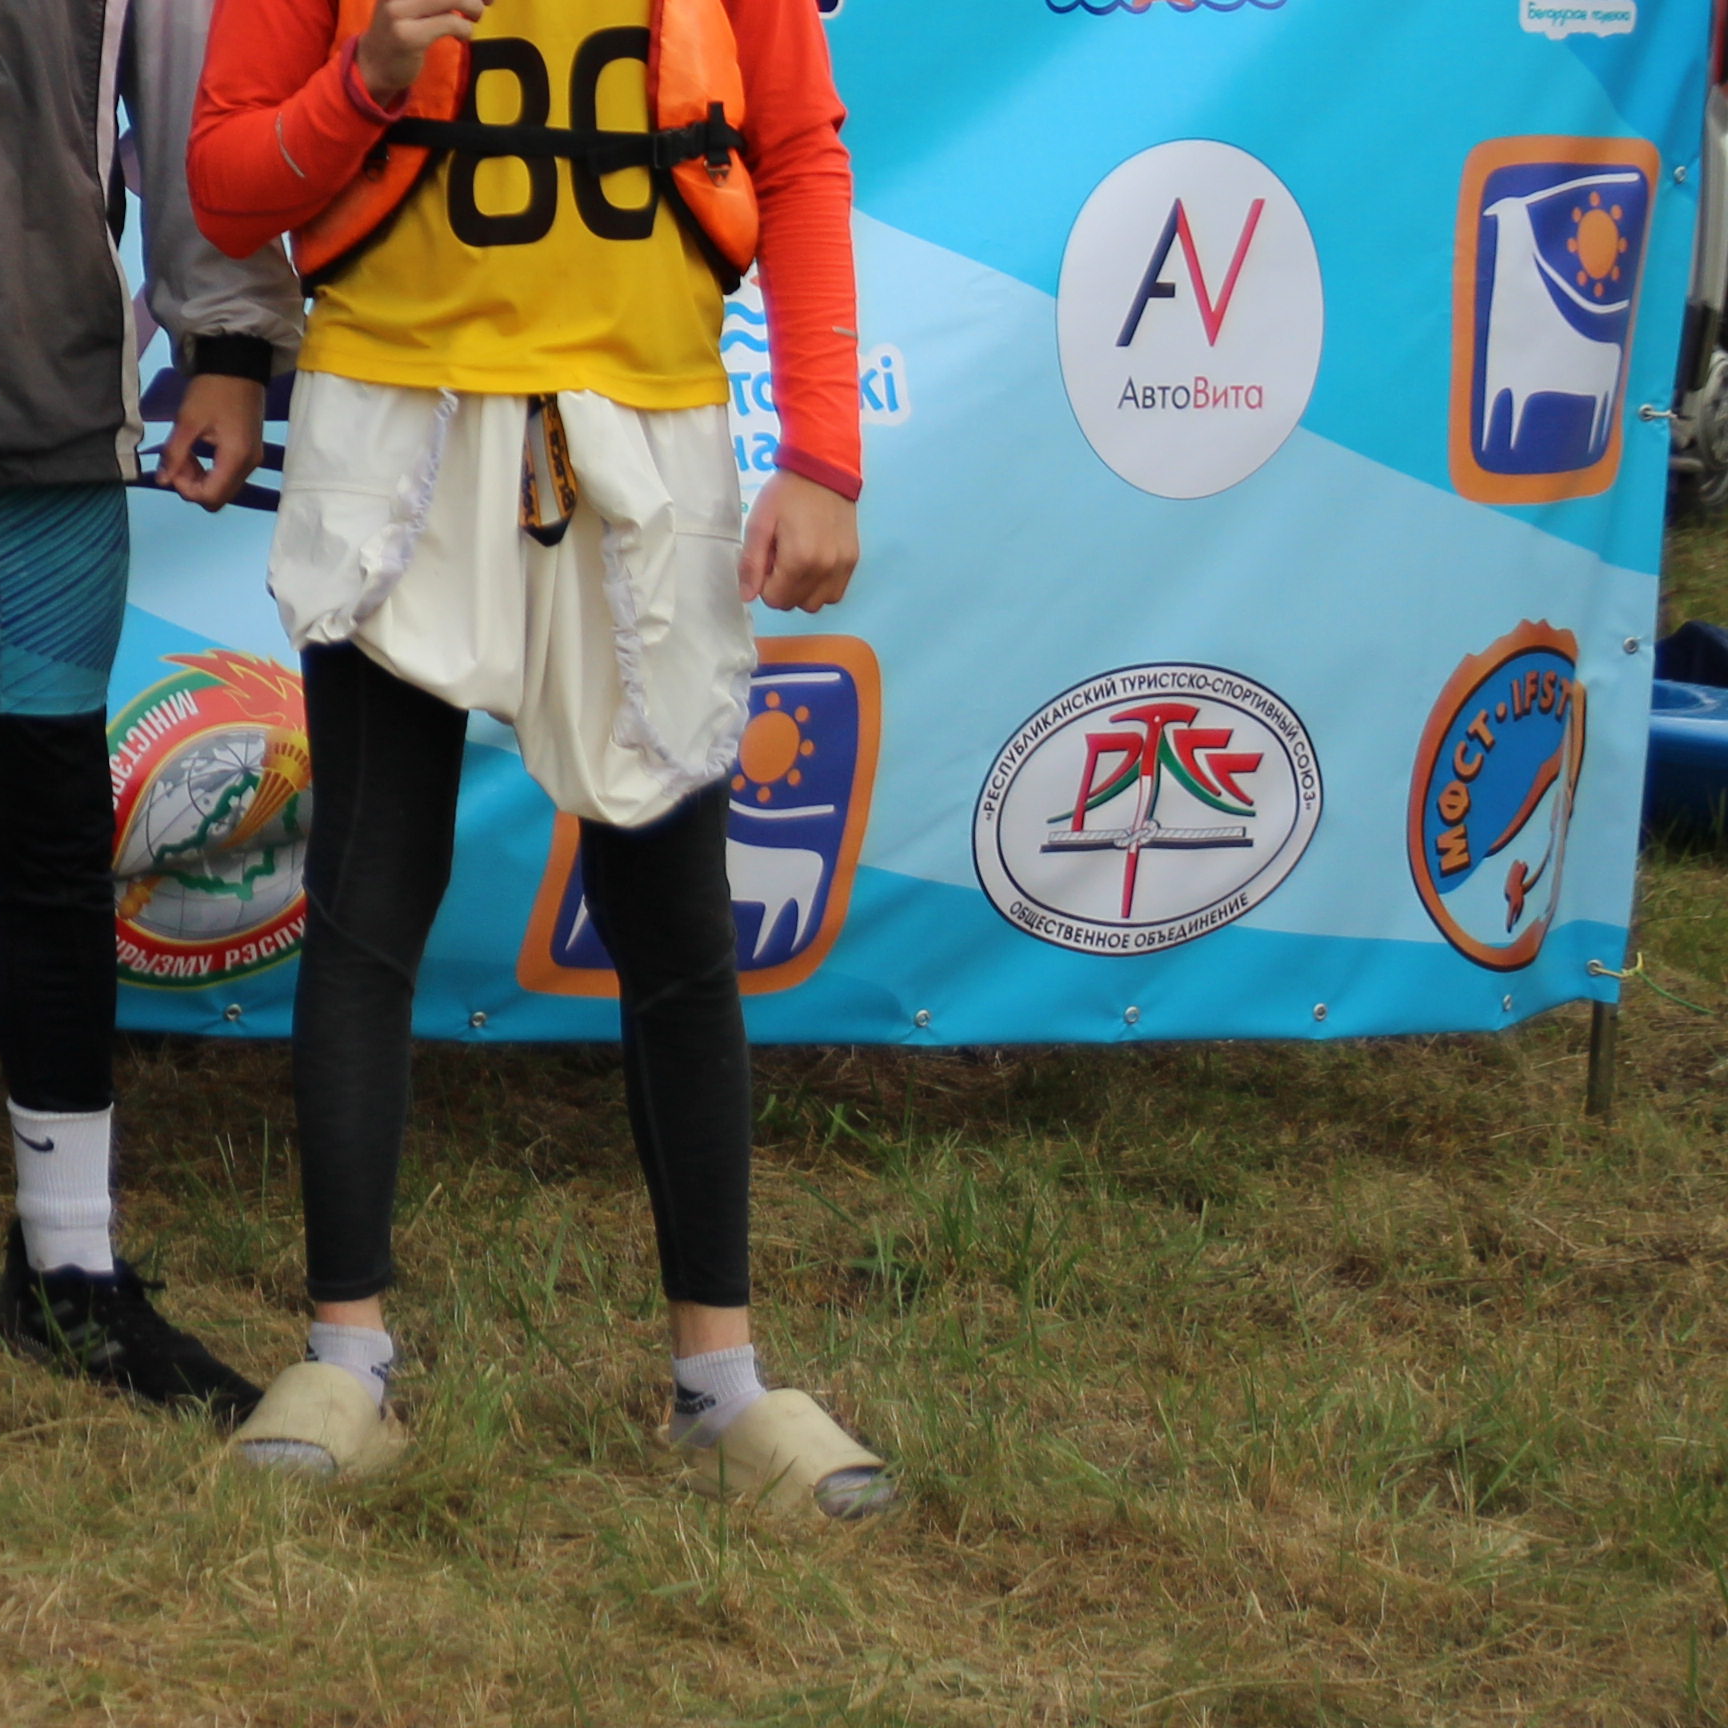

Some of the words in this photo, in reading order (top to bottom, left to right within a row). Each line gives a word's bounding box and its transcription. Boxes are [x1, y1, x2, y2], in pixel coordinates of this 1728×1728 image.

[1117, 375, 1264, 410] АвтоВита
[1121, 671, 1300, 743] ТУРИСТСКО-СПОРТИВНЫЙ
[109, 688, 200, 802] МІНІСТЭР
[225, 915, 307, 971] РЭСПУ
[1009, 900, 1131, 949] ОБЩЕСТВЕННОЕ
[1134, 893, 1249, 948] ОБЪЕДИНЕНИЕ
